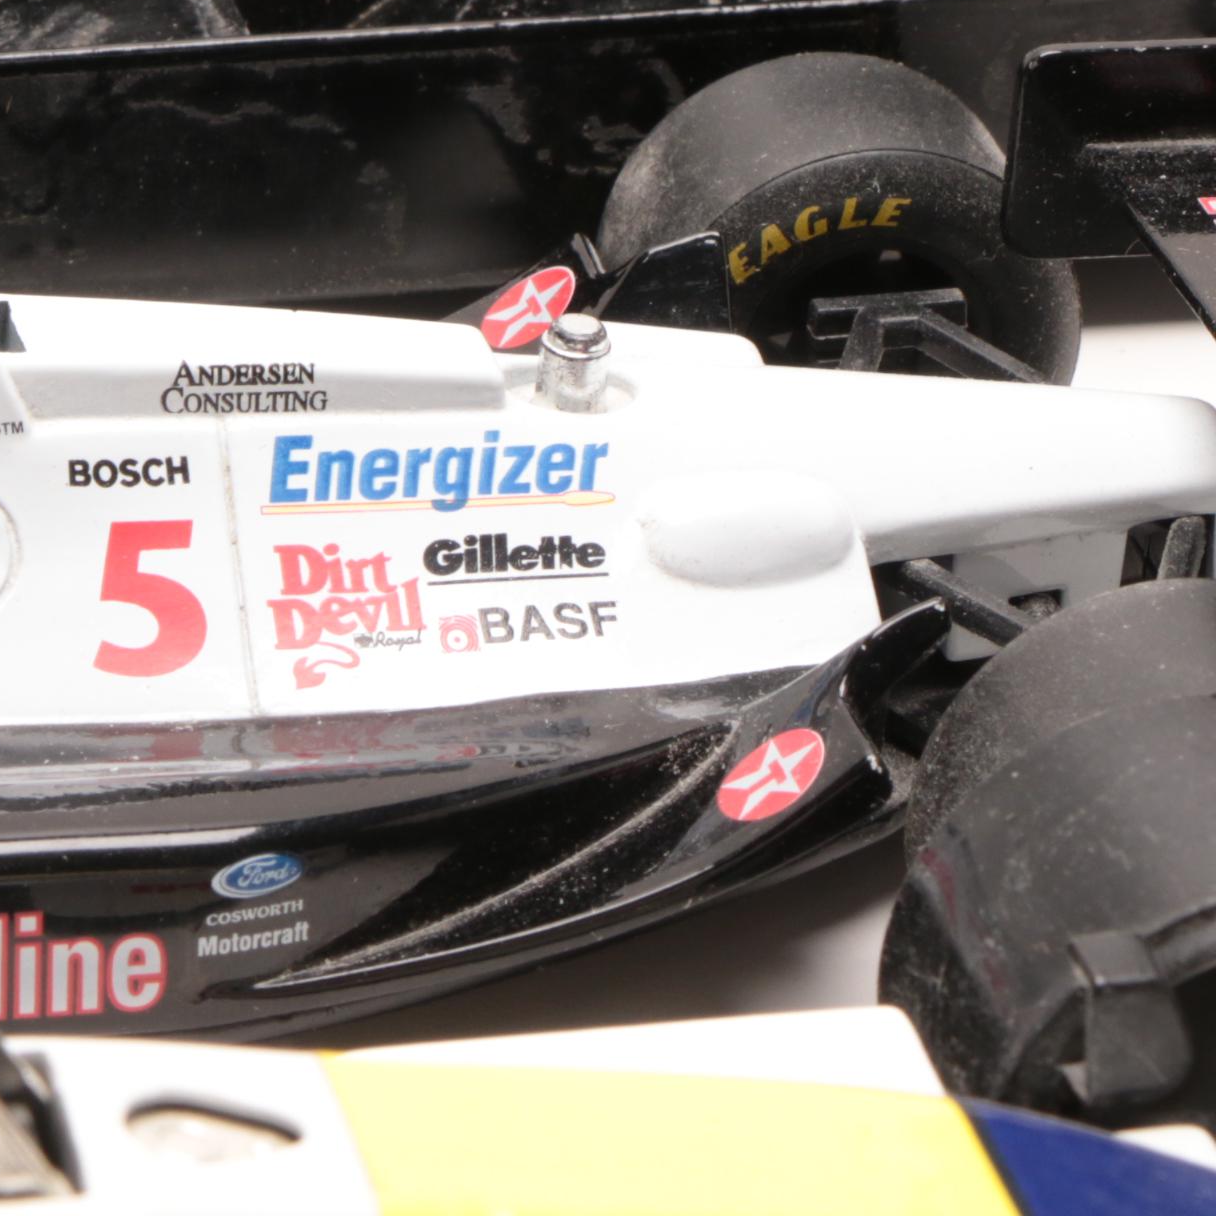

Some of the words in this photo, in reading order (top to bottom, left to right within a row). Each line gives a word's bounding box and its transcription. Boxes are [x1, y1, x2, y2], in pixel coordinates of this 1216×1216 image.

[727, 196, 914, 285] EAGLE
[172, 360, 316, 386] ANDERSEN
[160, 386, 329, 415] CONSULTING
[67, 455, 191, 488] BOSCH
[268, 430, 609, 513] Energizer
[273, 543, 393, 596] Dirt
[422, 533, 607, 577] Gillette
[92, 519, 209, 678] 5
[266, 577, 427, 660] Devil
[478, 600, 618, 645] BASF
[205, 899, 304, 926] COSWORTH
[196, 920, 310, 957] Motorcraft
